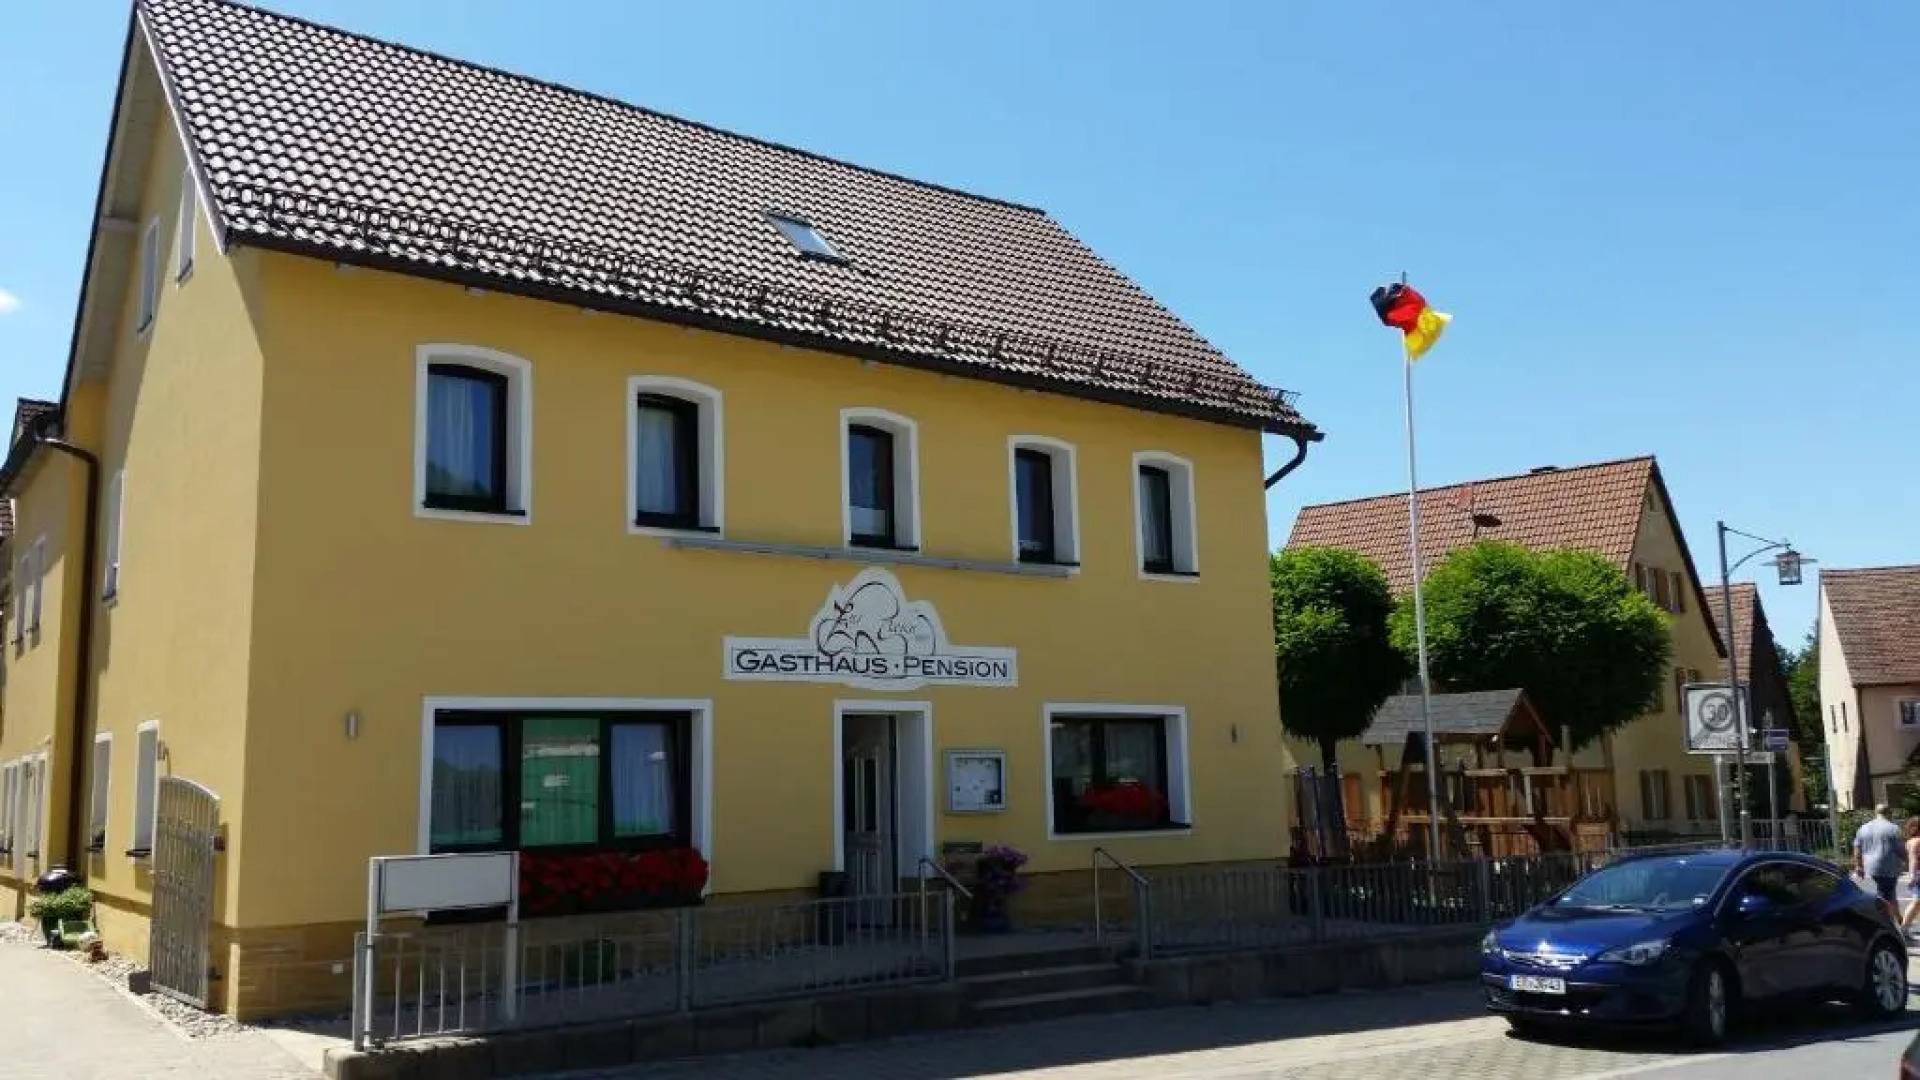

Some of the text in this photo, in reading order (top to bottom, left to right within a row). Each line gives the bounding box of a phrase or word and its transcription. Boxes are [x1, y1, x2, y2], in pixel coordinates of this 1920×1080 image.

[736, 650, 1008, 678] GASTHAUS PENSION
[1706, 703, 1728, 722] 30
